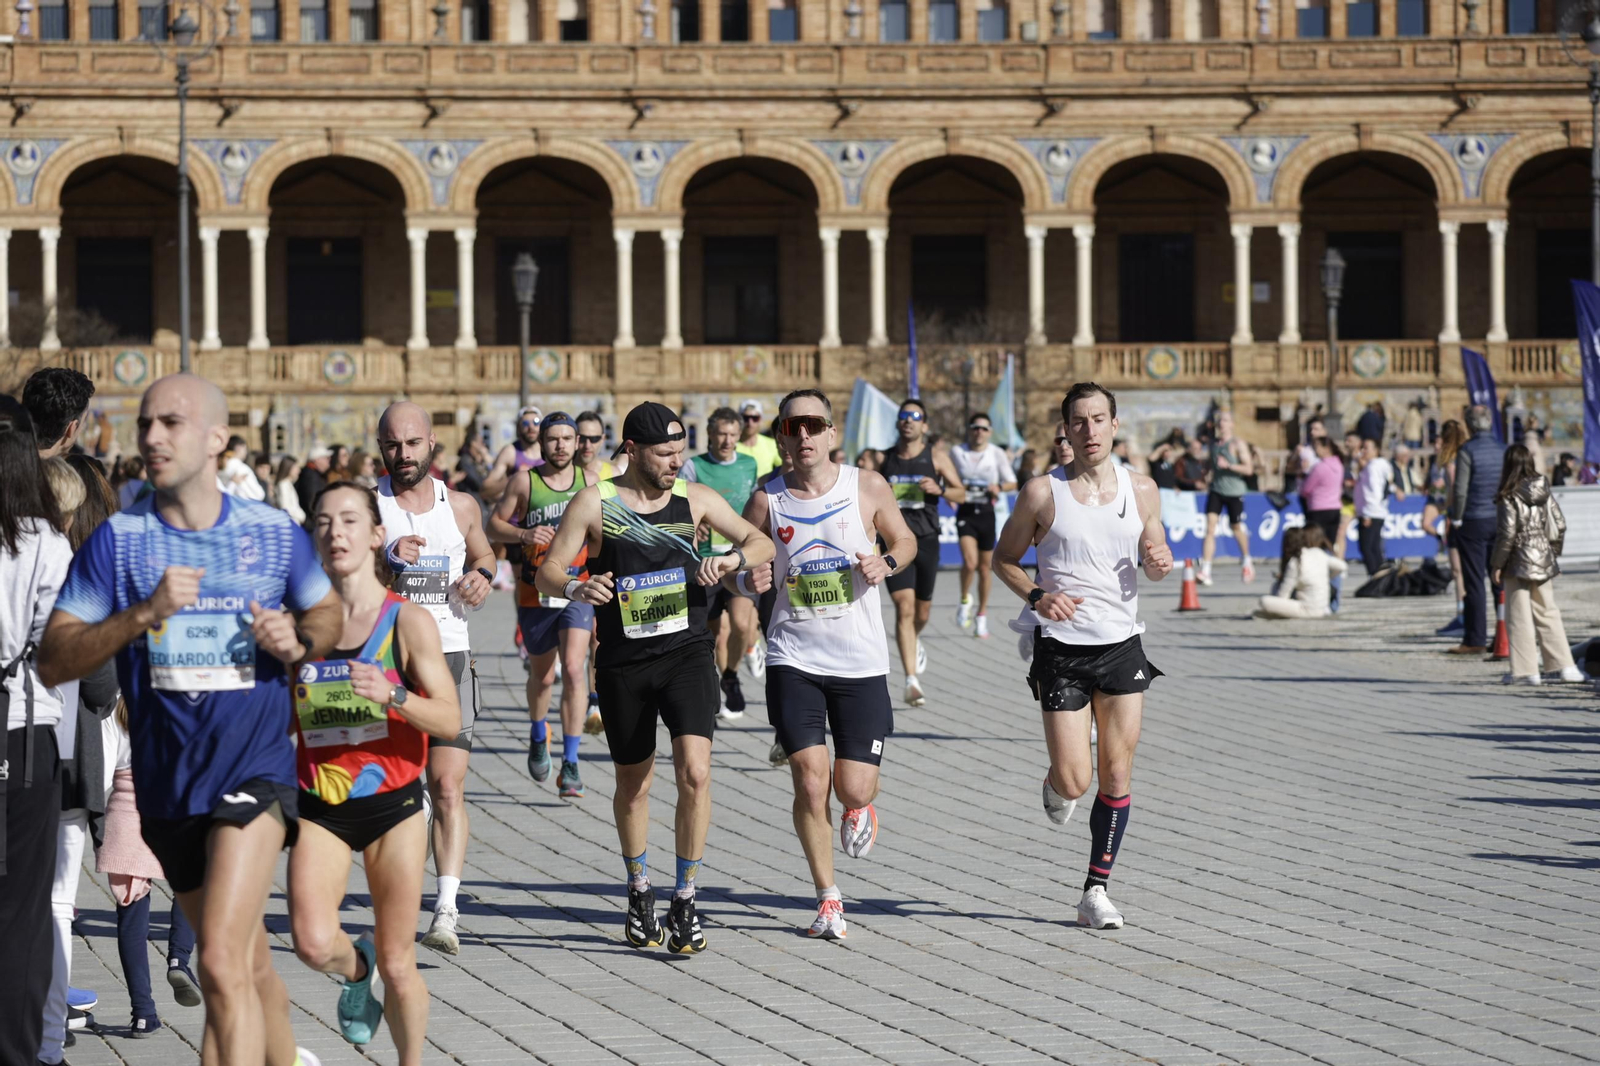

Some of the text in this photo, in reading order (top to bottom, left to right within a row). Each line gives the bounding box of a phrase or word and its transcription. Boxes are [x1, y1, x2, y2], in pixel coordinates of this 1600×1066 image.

[527, 508, 542, 527] LOS
[1380, 512, 1427, 539] sics
[805, 560, 842, 572] ZURICH
[406, 577, 427, 587] 4077
[640, 572, 678, 586] ZURICH
[808, 579, 829, 589] 1930
[643, 593, 664, 605] 2004
[802, 590, 839, 604] WAIDI
[631, 603, 680, 622] BERNAL
[186, 626, 218, 638] 6296
[151, 652, 216, 666] EDUARDO
[322, 664, 350, 678] ZUR
[326, 690, 352, 703] 2603
[311, 706, 374, 725] JEMIMA
